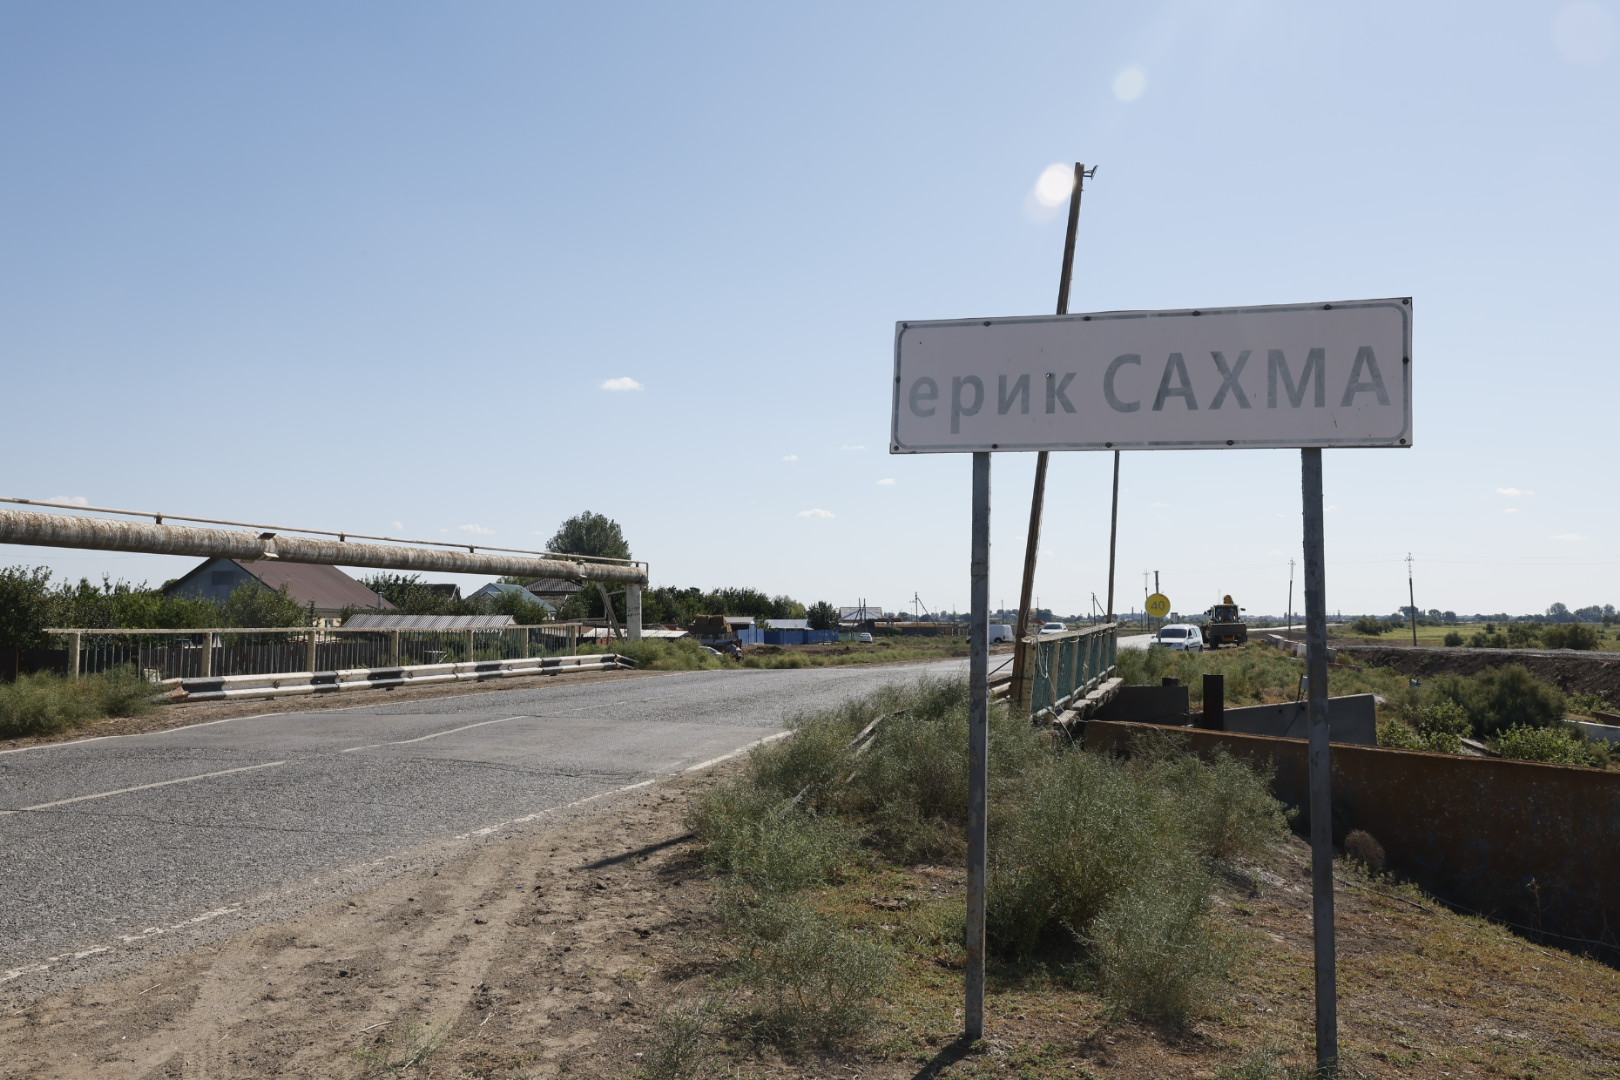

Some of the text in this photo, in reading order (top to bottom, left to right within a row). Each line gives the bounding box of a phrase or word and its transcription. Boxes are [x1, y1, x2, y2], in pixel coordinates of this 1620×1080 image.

[908, 345, 1391, 434] ерик САХМА
[1151, 601, 1166, 611] 40
